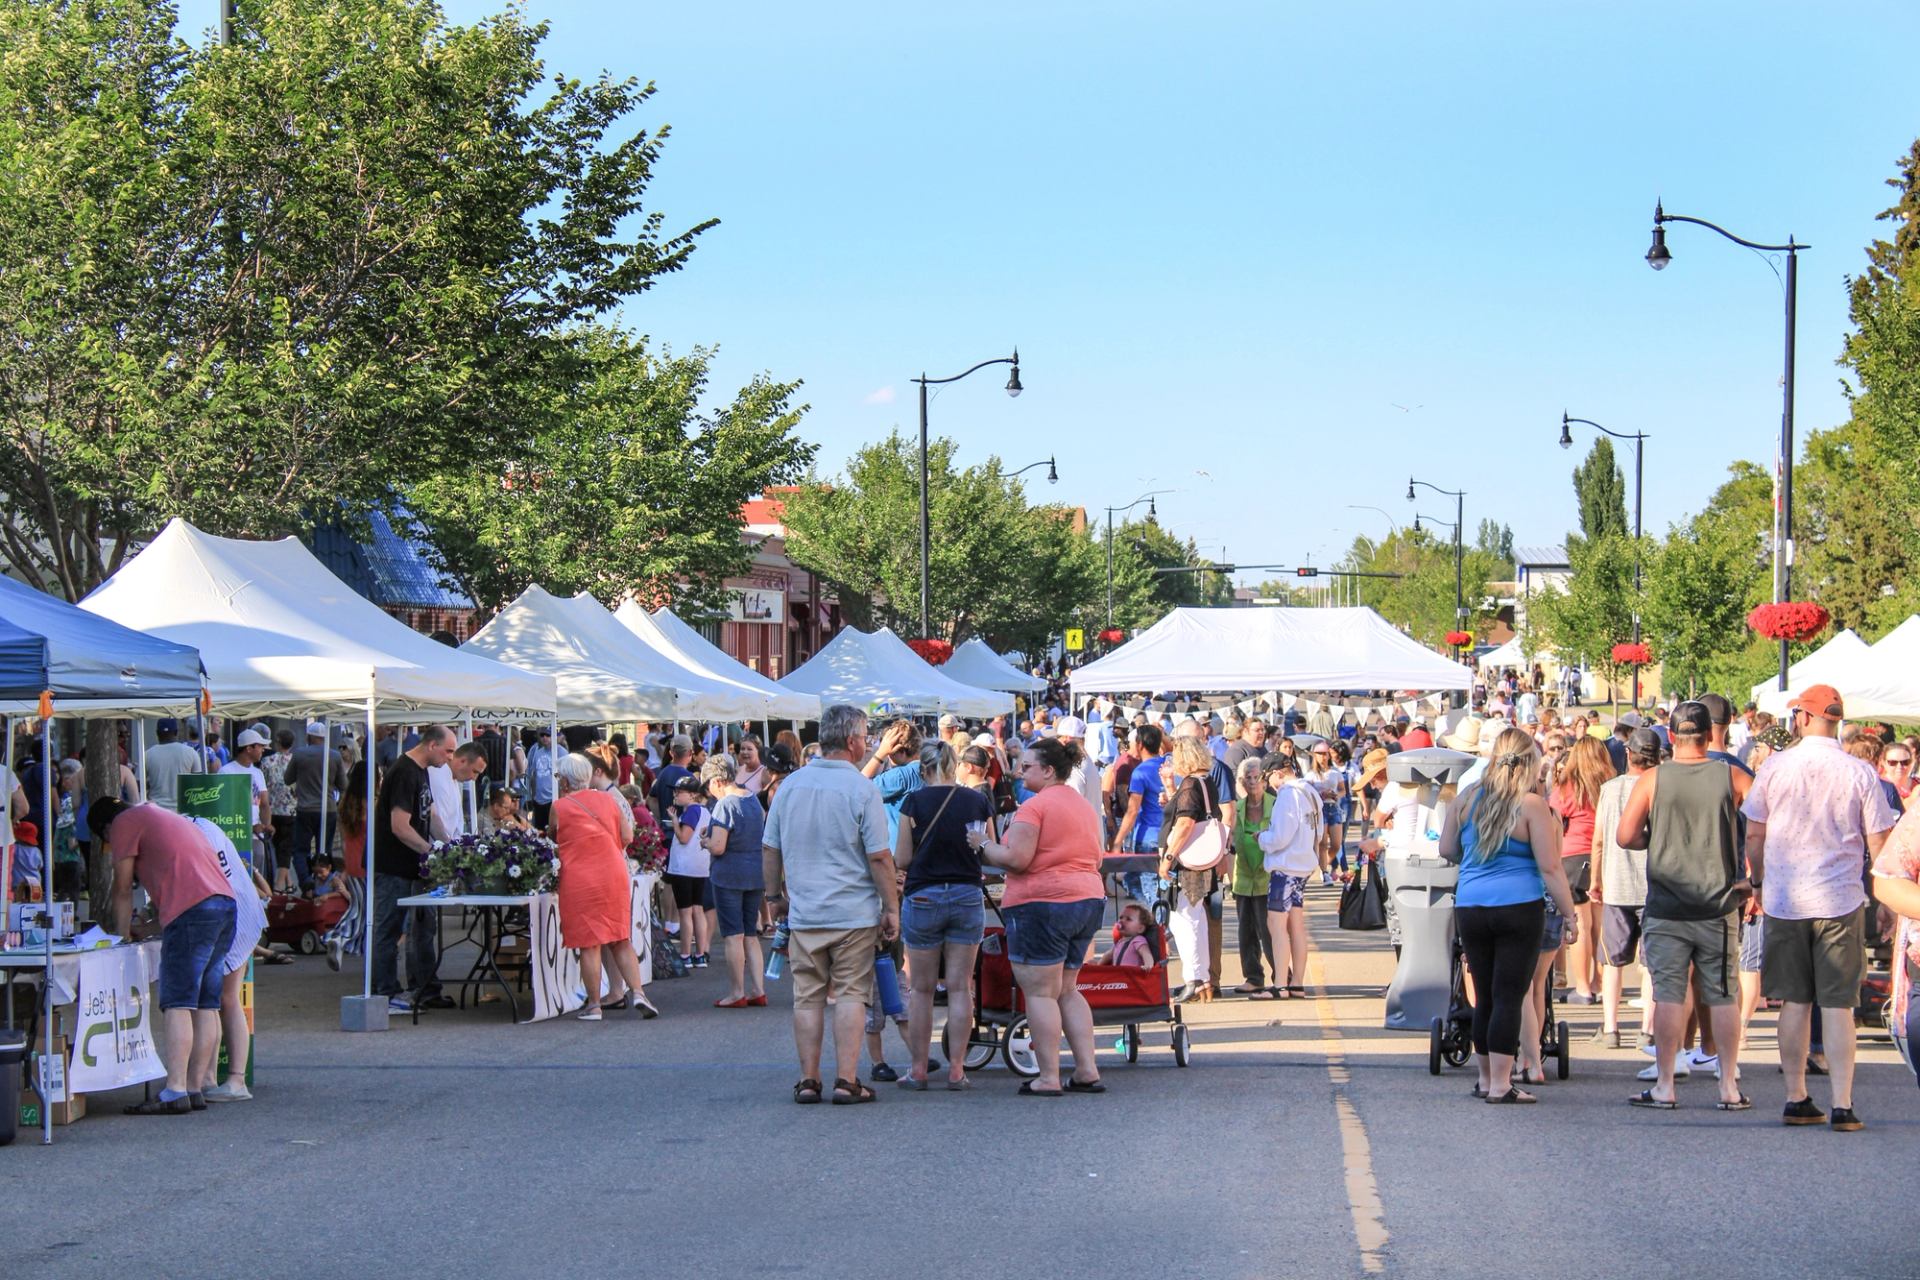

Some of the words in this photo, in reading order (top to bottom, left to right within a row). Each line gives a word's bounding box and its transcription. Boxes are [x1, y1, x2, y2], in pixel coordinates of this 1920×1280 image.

[184, 783, 225, 805] Tweed
[235, 814, 246, 825] it.
[236, 828, 247, 839] it.
[85, 989, 113, 1017] JeB's
[121, 1033, 148, 1063] Joint
